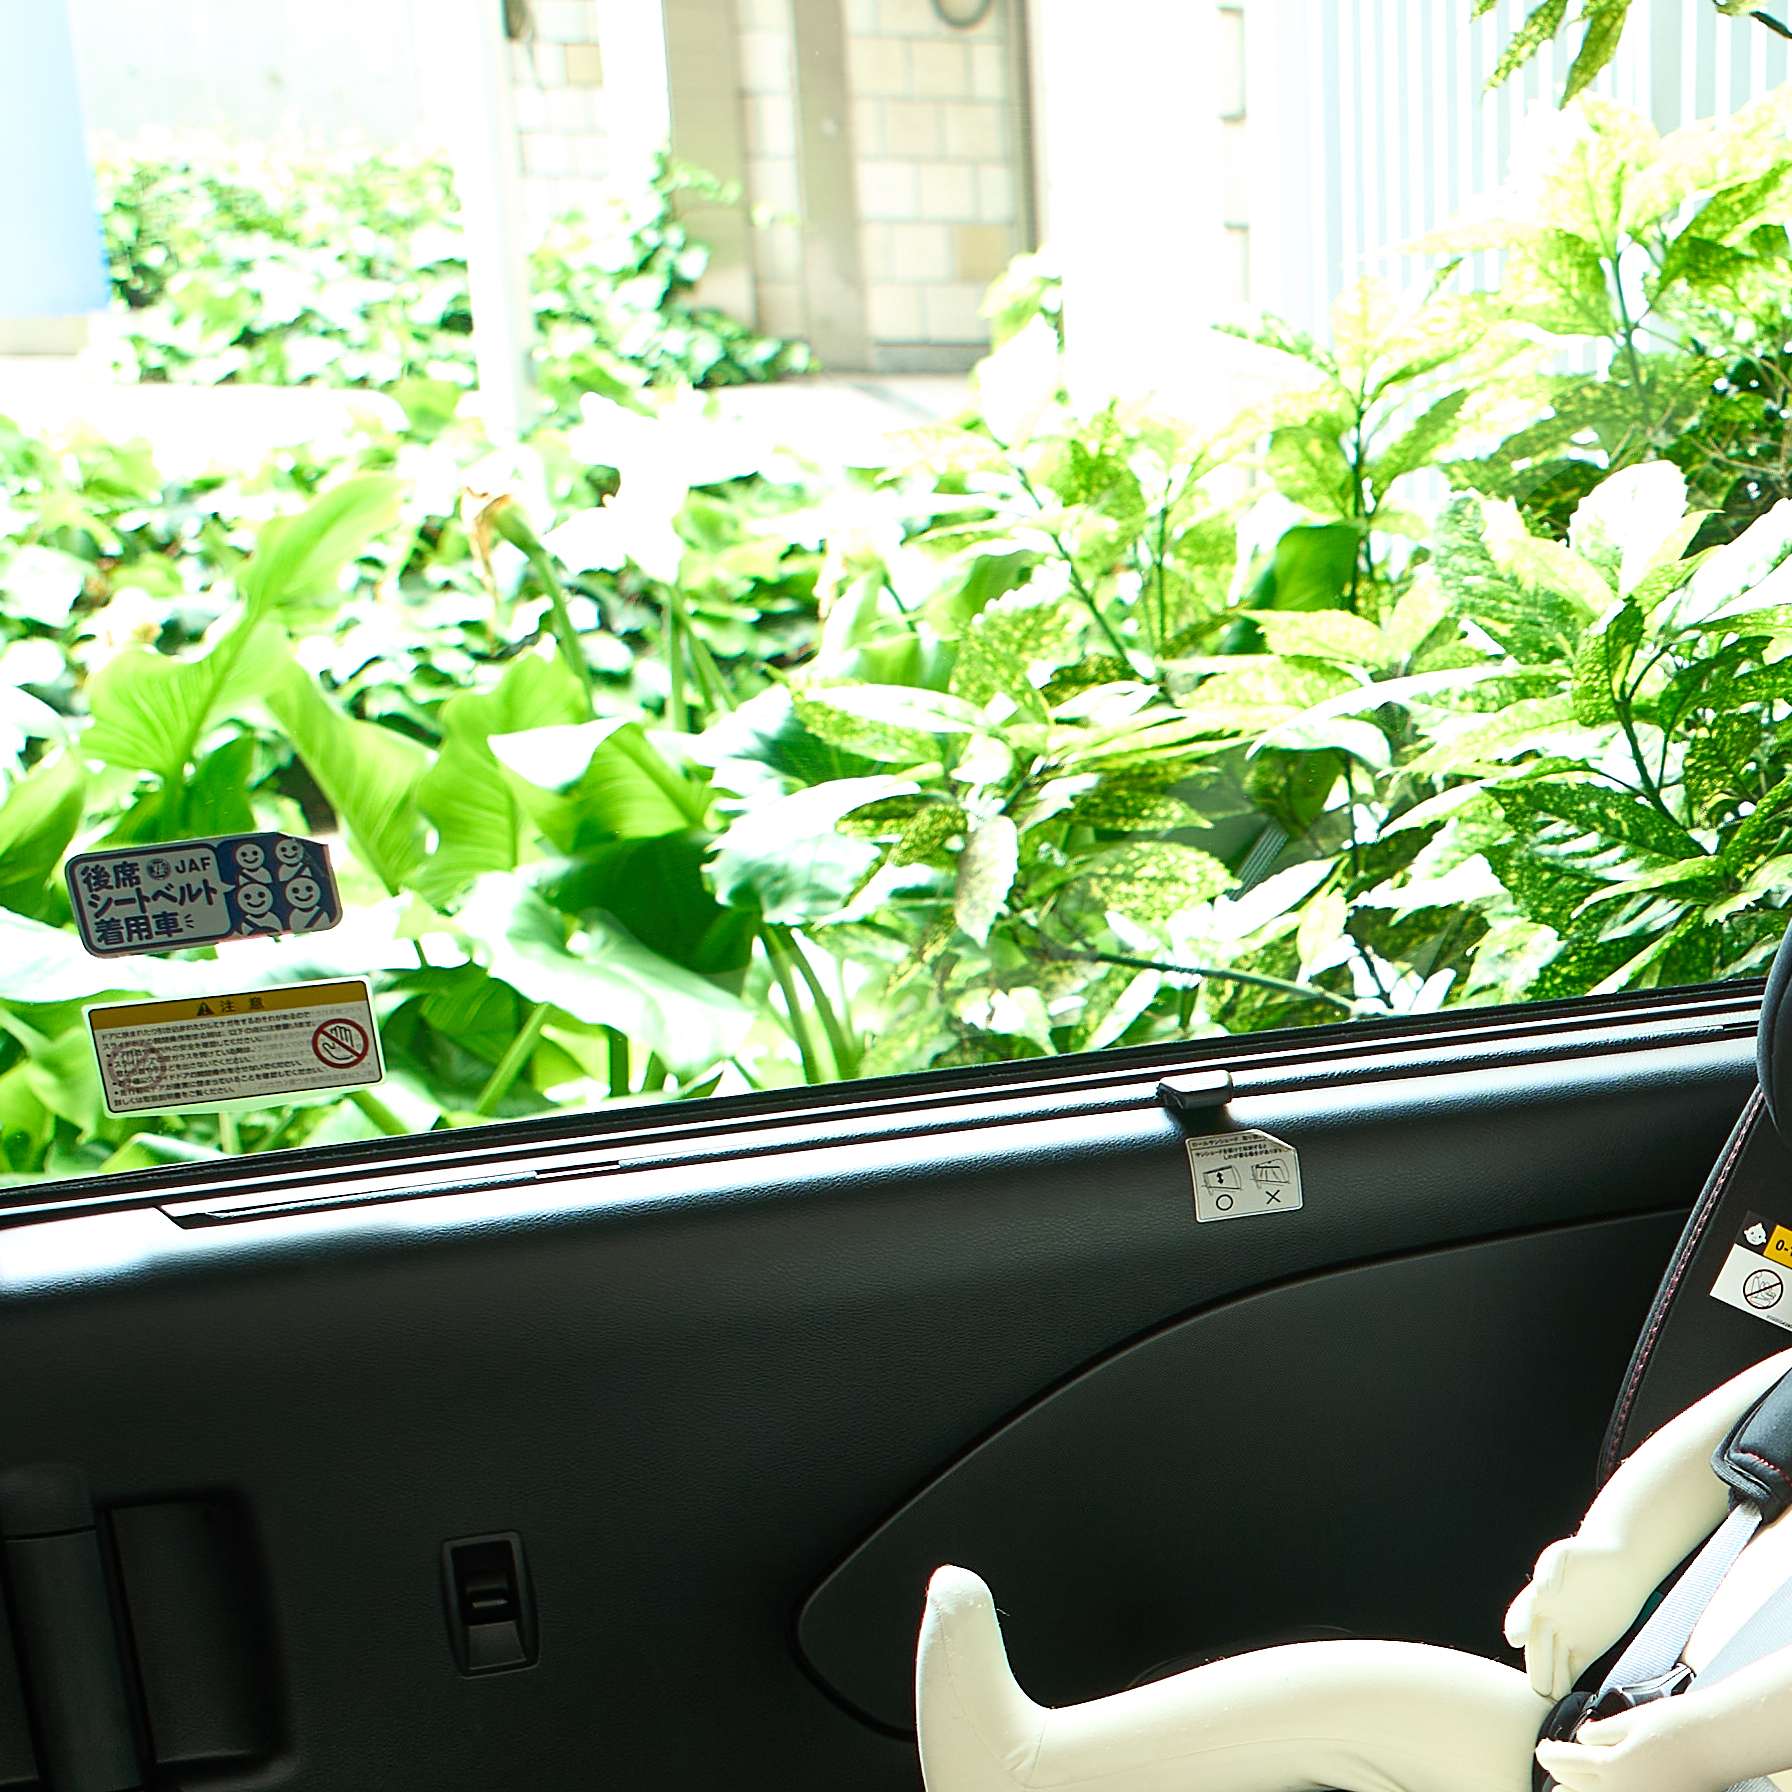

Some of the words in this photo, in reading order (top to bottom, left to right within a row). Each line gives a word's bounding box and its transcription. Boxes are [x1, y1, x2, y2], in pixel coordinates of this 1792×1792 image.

[81, 861, 142, 893] 後席
[174, 856, 211, 874] JAF
[87, 877, 218, 919] シートベルト
[94, 910, 184, 946] 着用車
